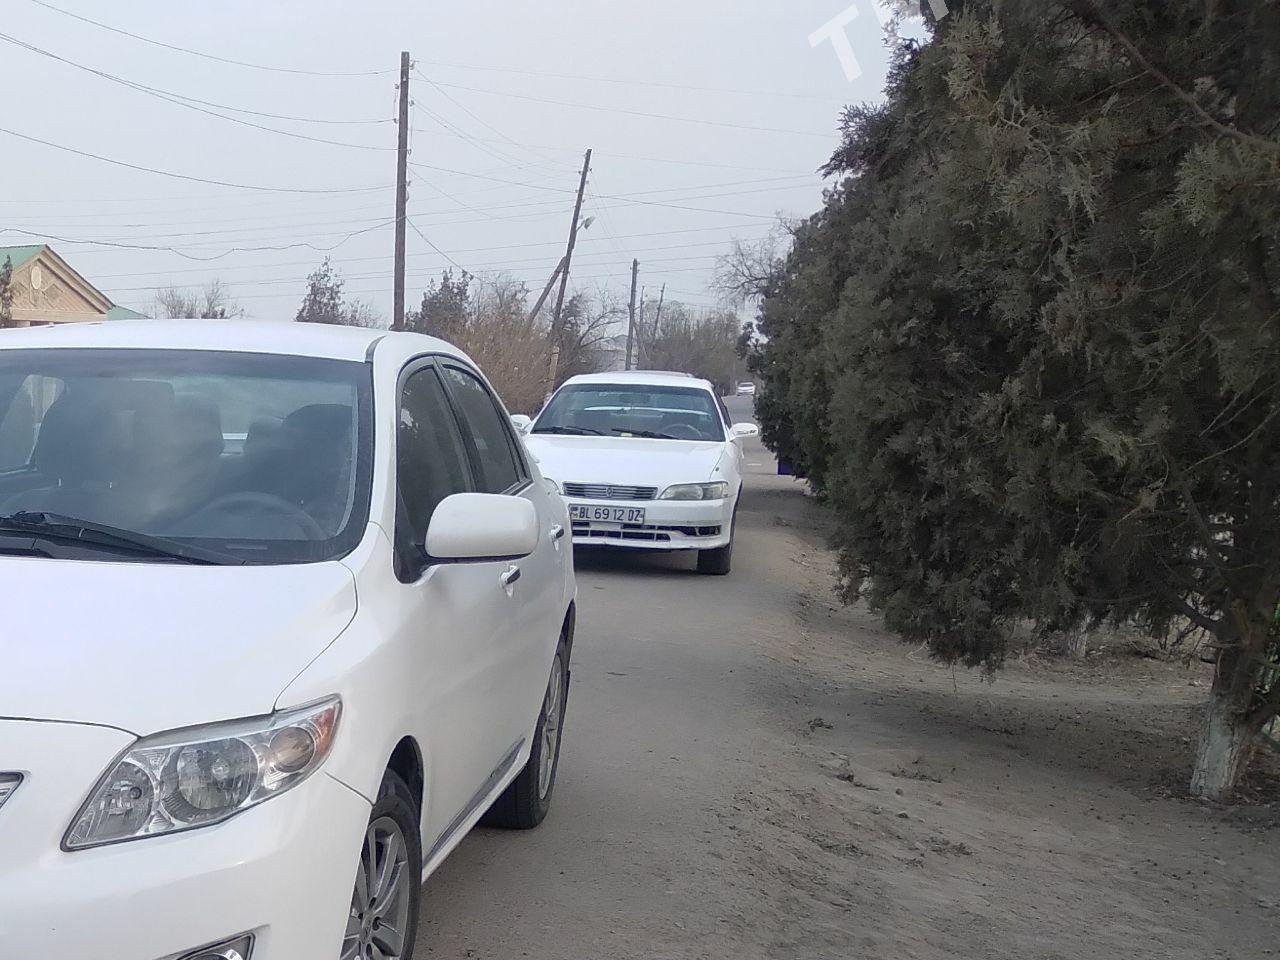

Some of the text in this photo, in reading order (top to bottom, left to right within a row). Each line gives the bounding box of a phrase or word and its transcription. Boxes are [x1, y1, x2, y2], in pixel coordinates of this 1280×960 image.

[579, 506, 591, 519] BL
[594, 508, 610, 520] 69
[613, 509, 625, 521] 12
